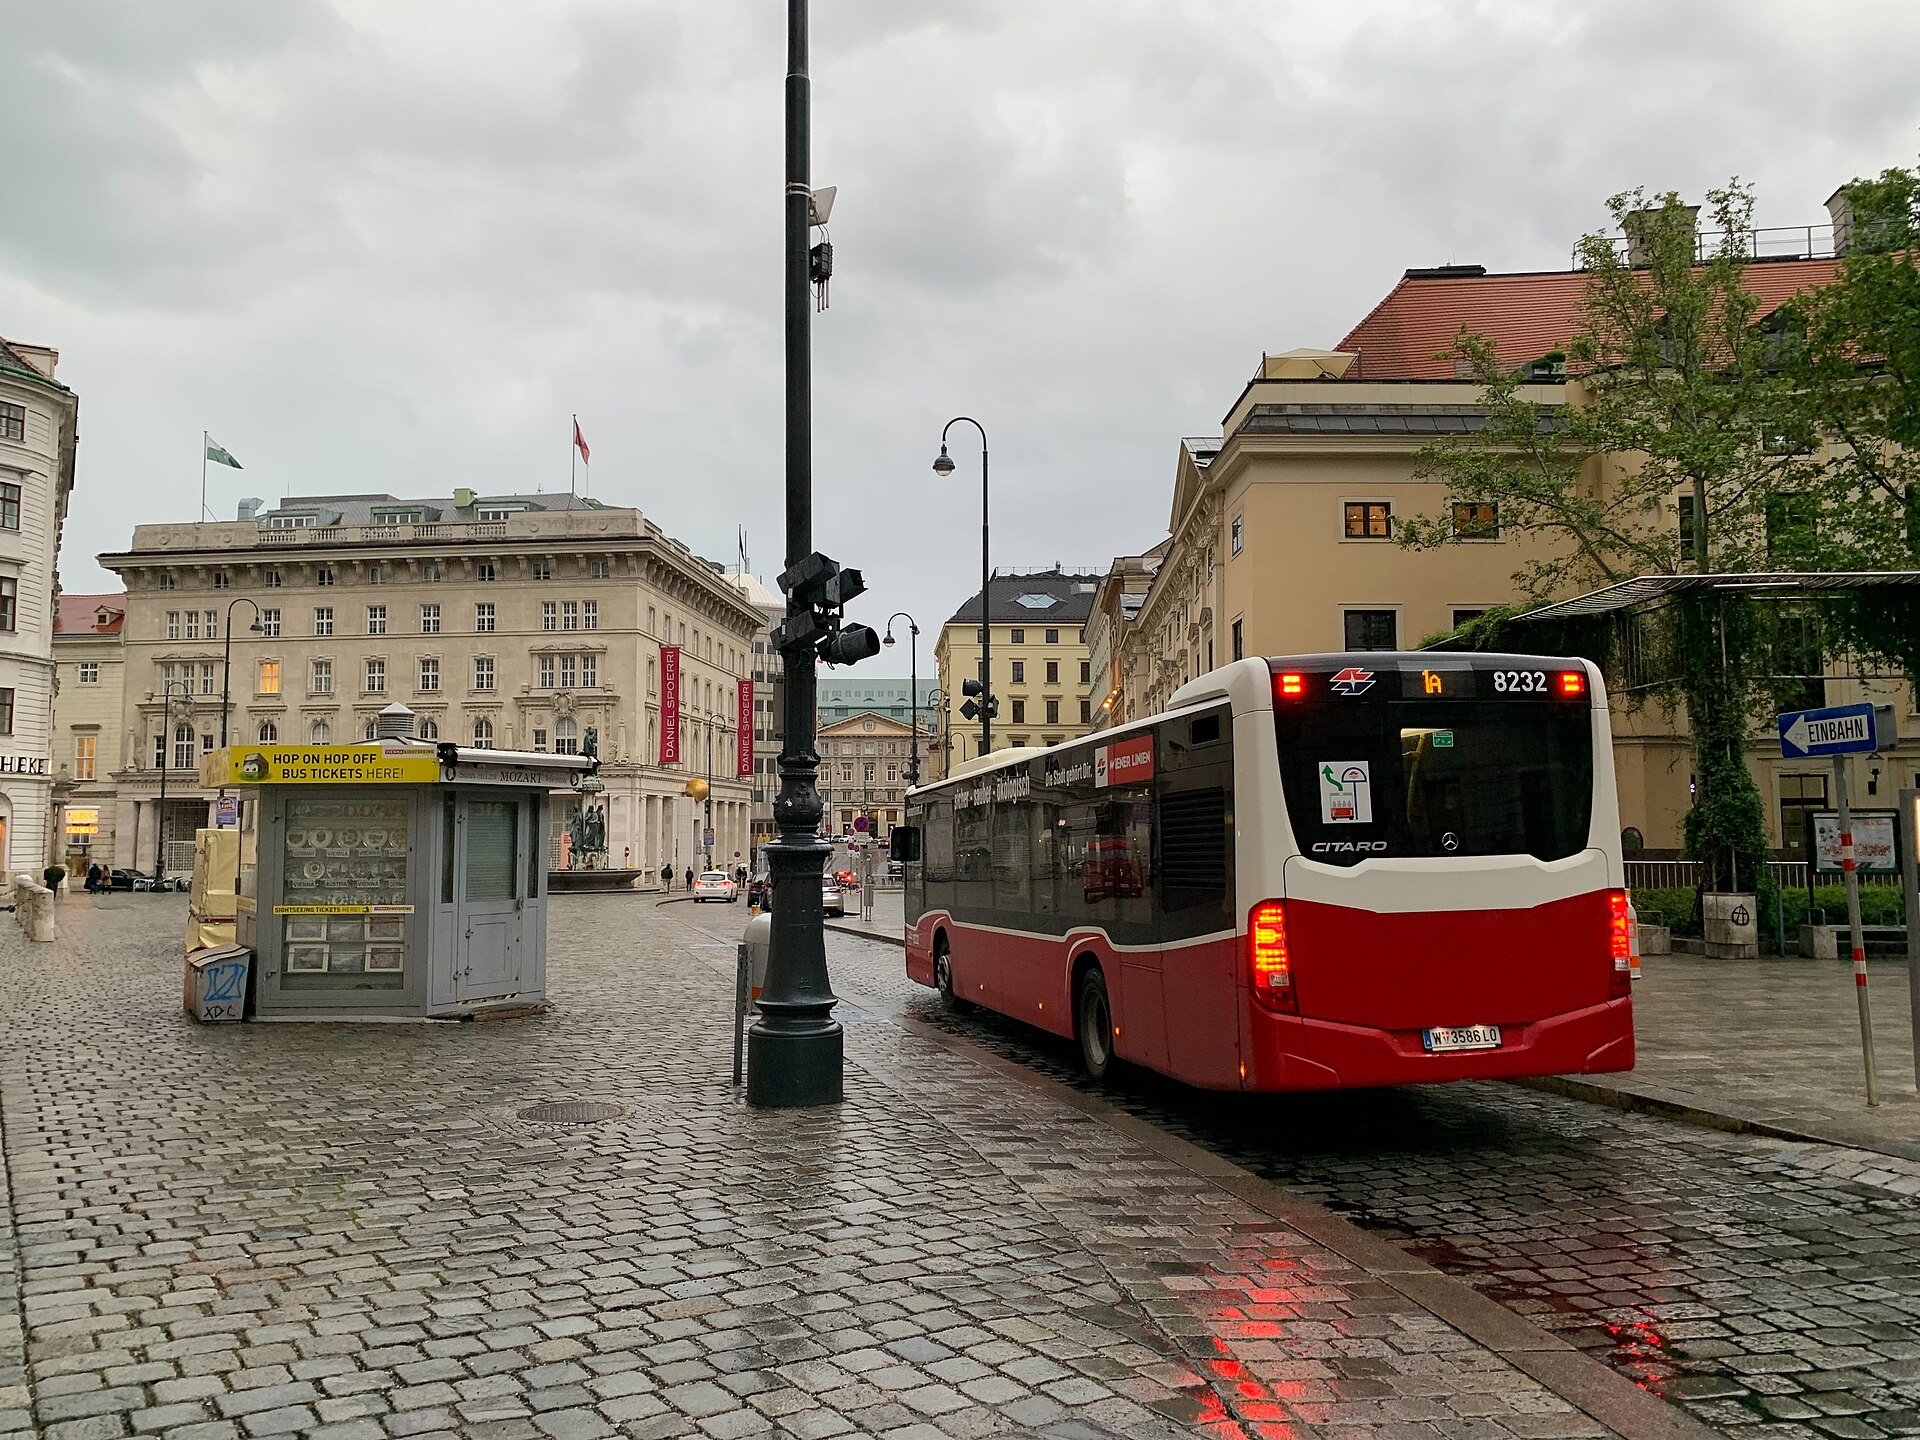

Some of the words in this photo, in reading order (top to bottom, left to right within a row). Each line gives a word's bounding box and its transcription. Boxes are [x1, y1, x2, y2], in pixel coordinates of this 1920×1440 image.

[666, 651, 675, 709] SPOERRI
[1421, 669, 1442, 694] 1A
[1493, 671, 1547, 692] 8232
[742, 683, 750, 731] SPOERRI
[666, 711, 675, 758] DANIEL
[1807, 718, 1864, 743] EINBAHN
[273, 753, 299, 764] HOP
[302, 753, 320, 764] ON
[324, 753, 350, 764] HOP
[352, 753, 377, 764] OFF
[742, 732, 750, 772] DANIEL
[1109, 755, 1131, 770] WIENER
[1131, 750, 1151, 766] LINIEN
[282, 768, 307, 779] BUS
[309, 768, 363, 779] TICKETS
[366, 768, 404, 779] HERE!
[500, 770, 543, 784] MOZART
[1311, 841, 1388, 852] CITARO
[1432, 1032, 1442, 1044] W
[1450, 1029, 1481, 1044] 3586
